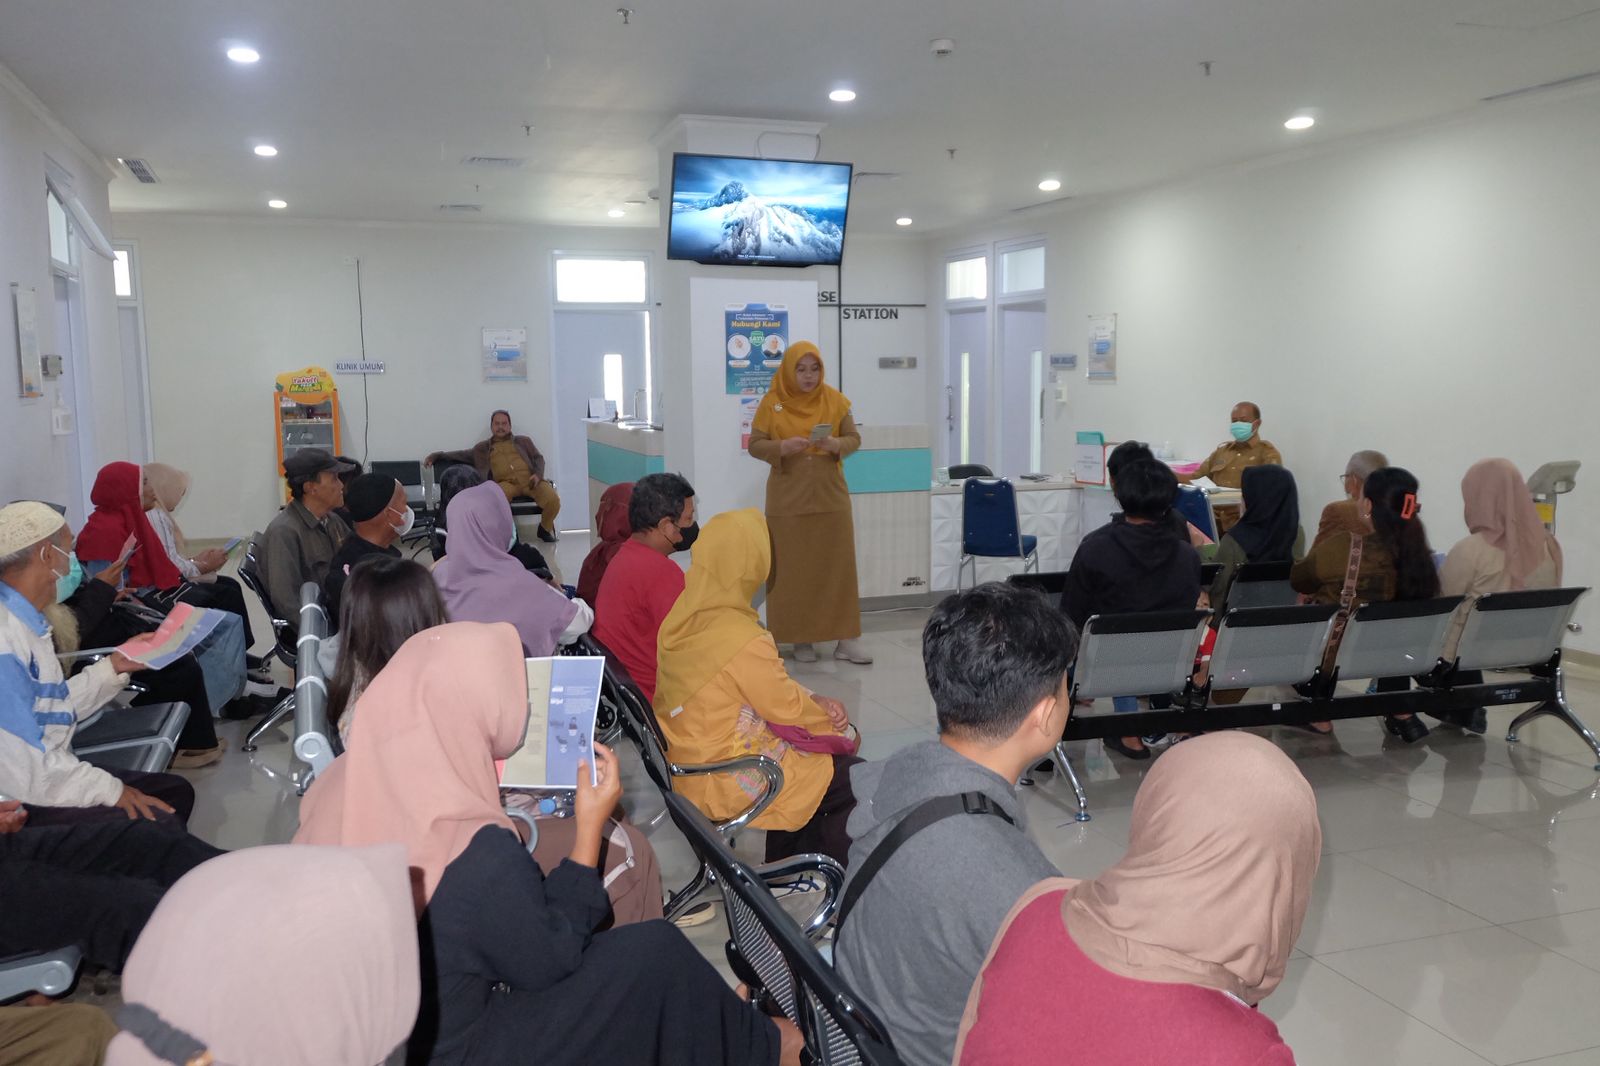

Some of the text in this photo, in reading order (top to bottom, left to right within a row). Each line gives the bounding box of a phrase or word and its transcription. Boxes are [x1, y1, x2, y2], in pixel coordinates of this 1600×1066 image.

[843, 308, 898, 319] STATION
[336, 362, 384, 370] KLINIK UMUM
